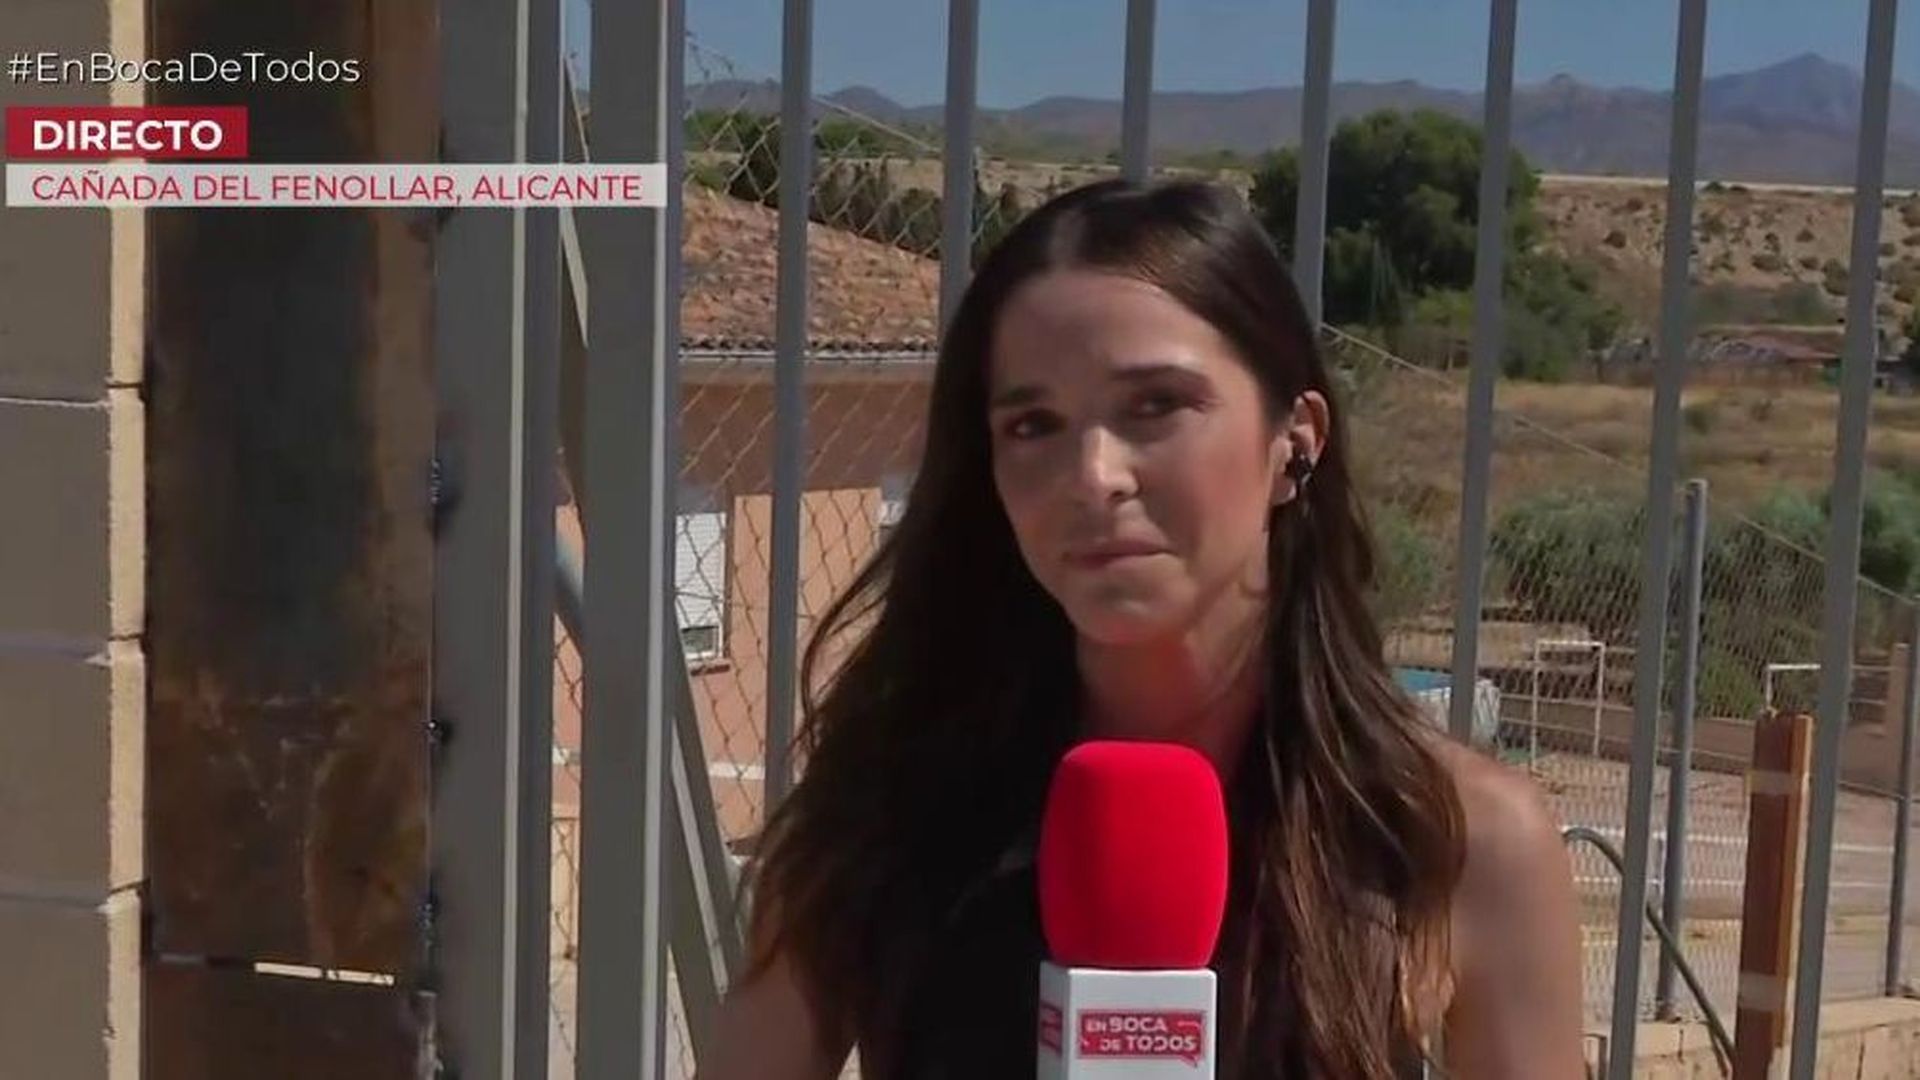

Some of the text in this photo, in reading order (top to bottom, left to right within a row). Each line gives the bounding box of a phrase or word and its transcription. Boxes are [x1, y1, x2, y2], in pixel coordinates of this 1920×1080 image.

[1085, 1016, 1169, 1033] EN BOCA
[1125, 1035, 1198, 1052] TODOS
